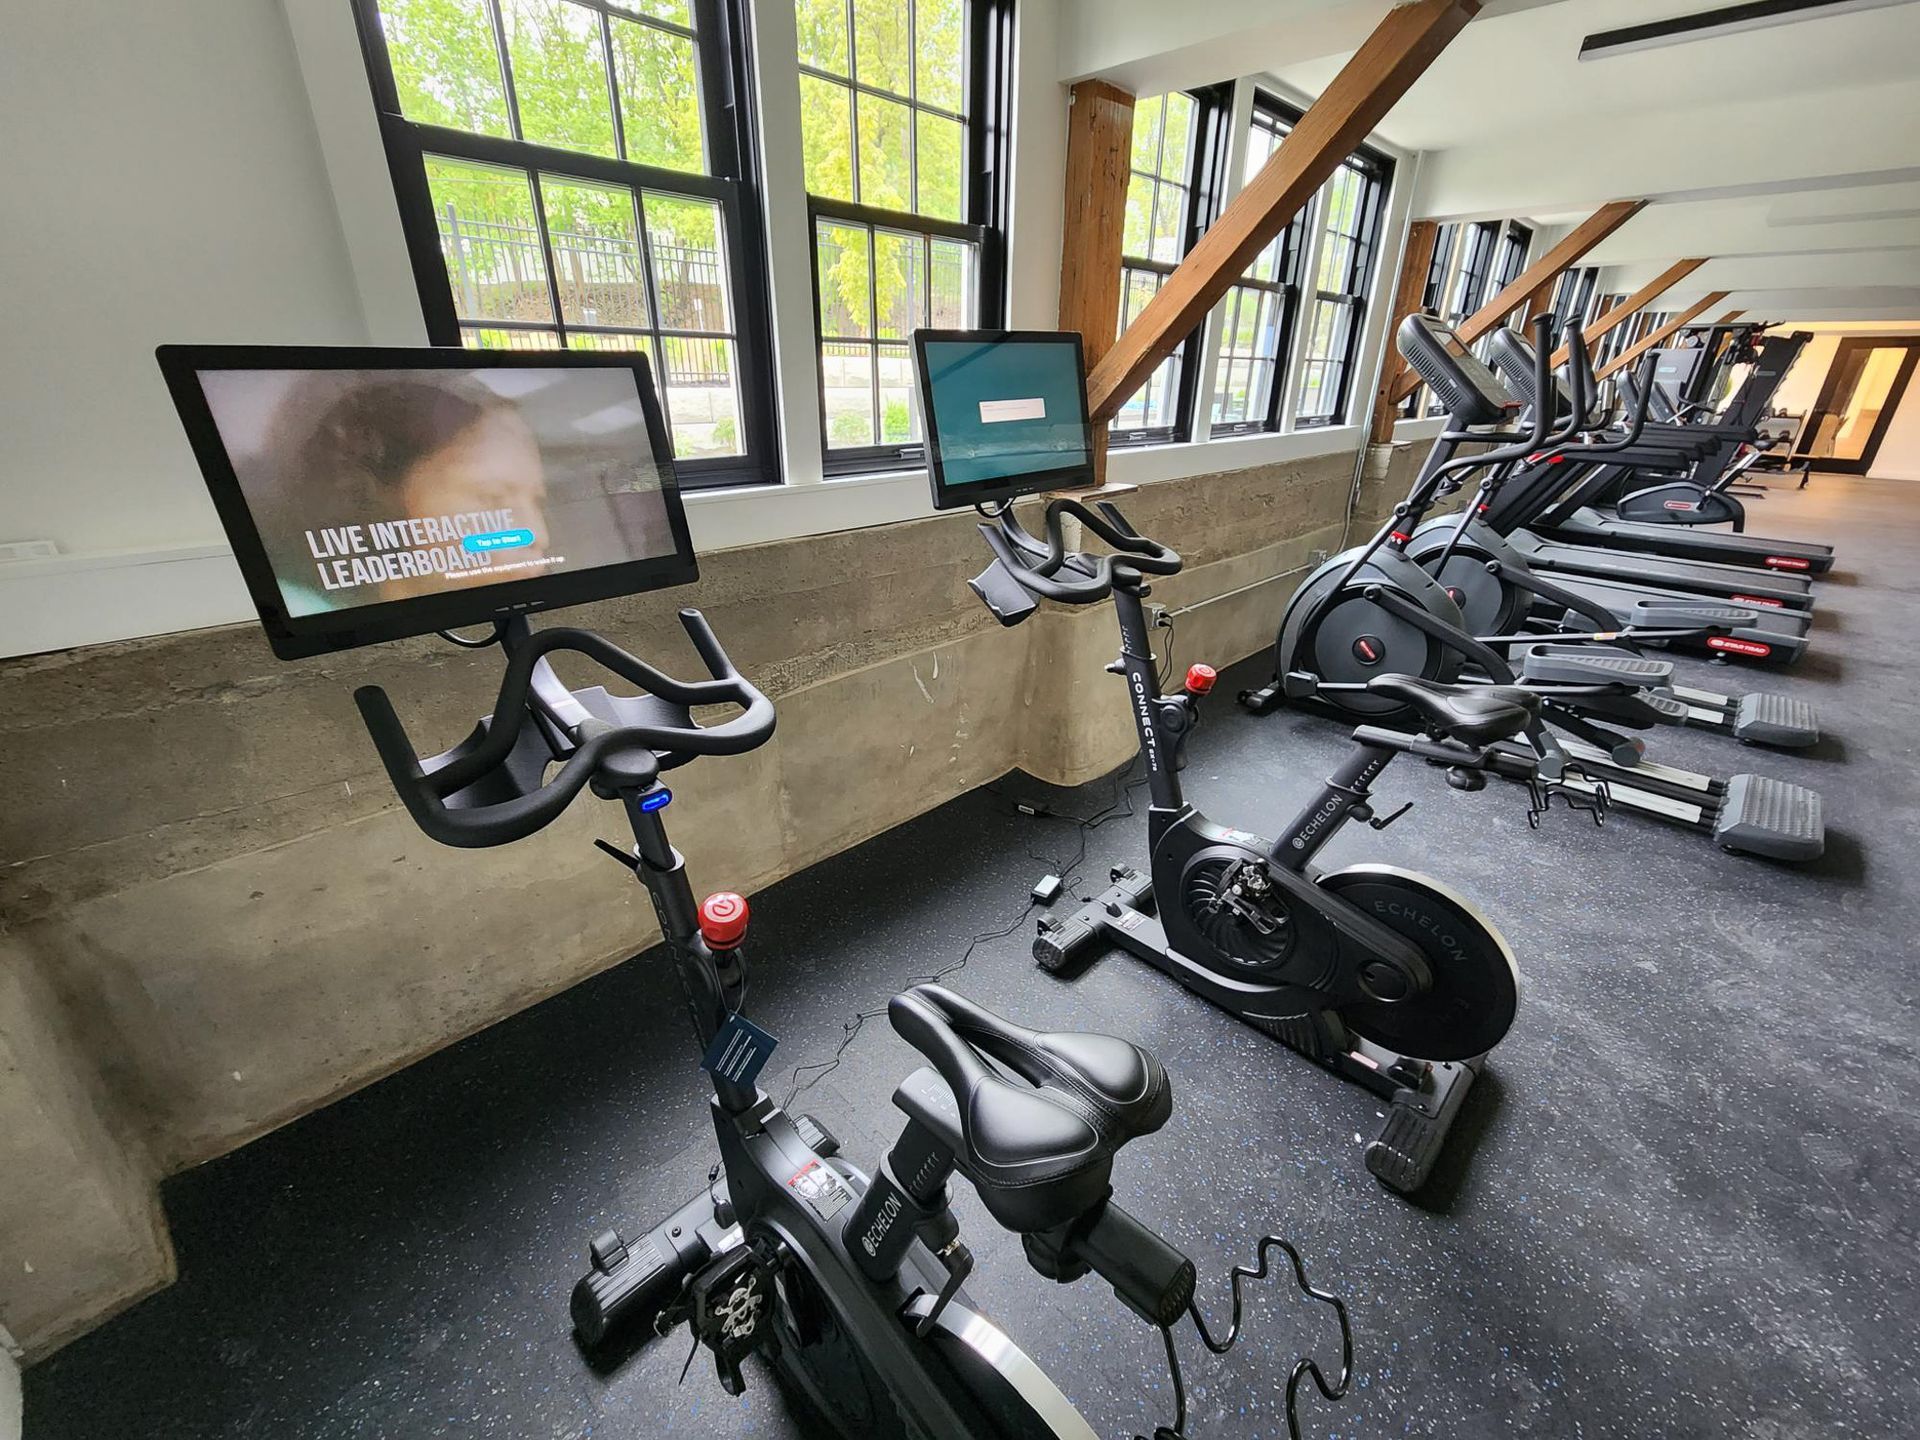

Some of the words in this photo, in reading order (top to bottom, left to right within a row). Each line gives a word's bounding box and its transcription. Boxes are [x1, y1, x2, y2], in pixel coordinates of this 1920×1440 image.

[305, 525, 368, 558] LIVE
[369, 508, 513, 550] INTERACTIVE
[317, 545, 491, 590] LEADERBOARD
[1132, 672, 1156, 747] CONNECT
[1299, 794, 1343, 842] ECHELON
[1374, 900, 1468, 961] ECHELON
[867, 1192, 902, 1248] ECHELON
